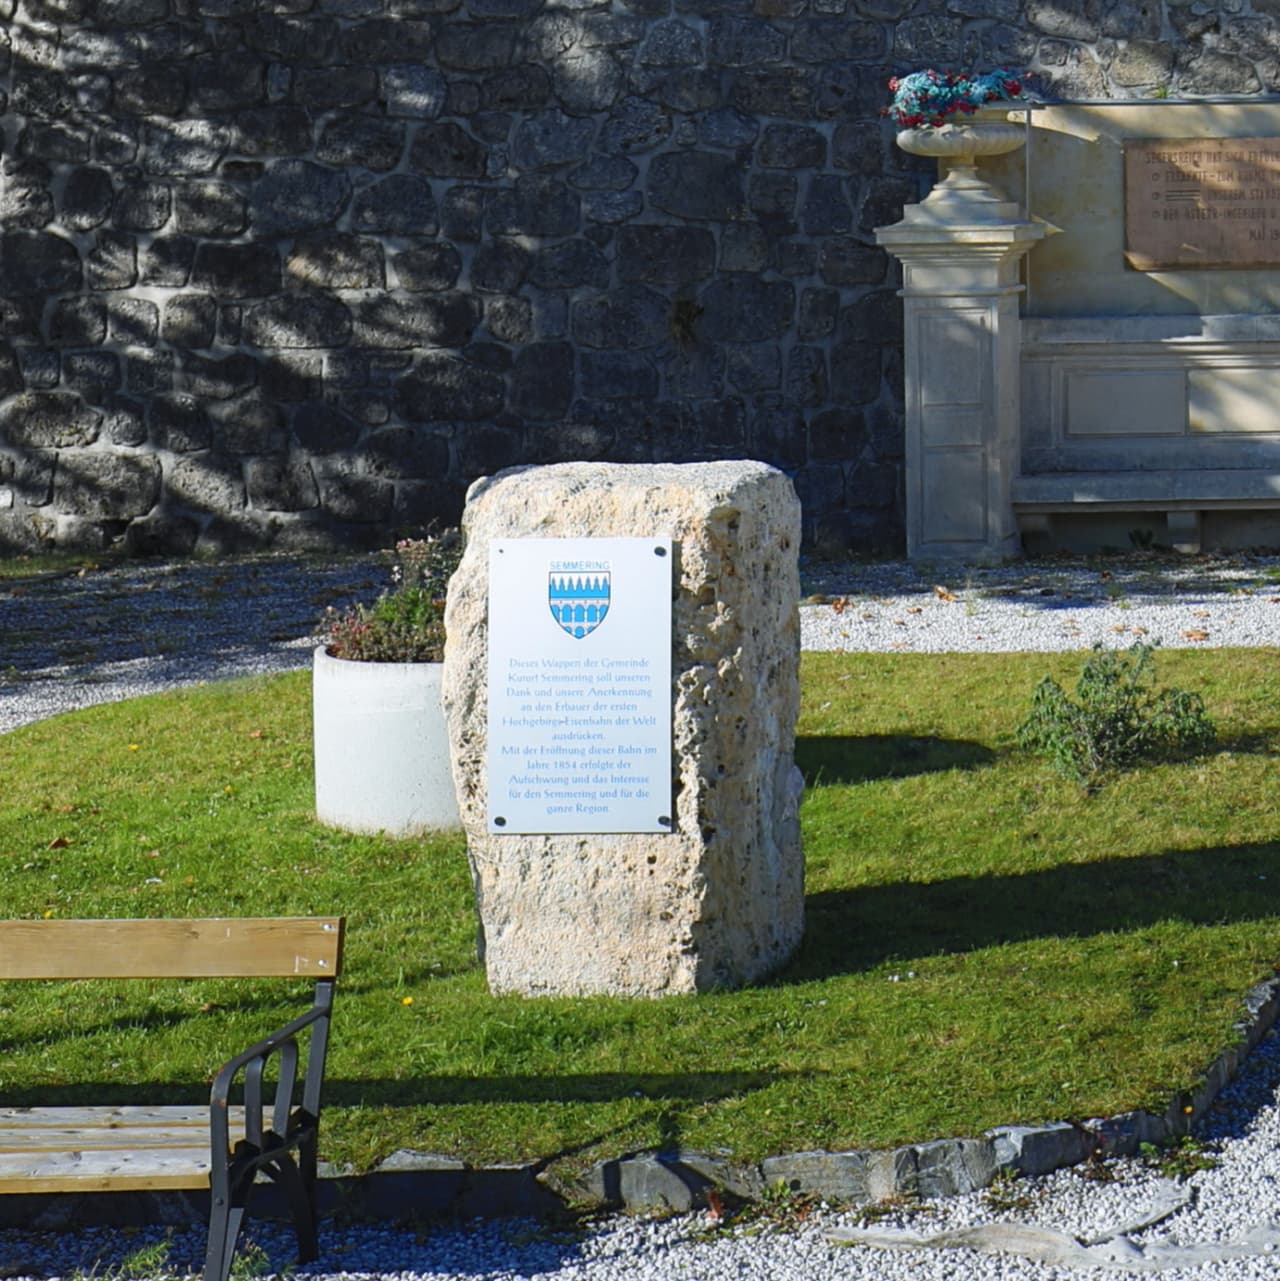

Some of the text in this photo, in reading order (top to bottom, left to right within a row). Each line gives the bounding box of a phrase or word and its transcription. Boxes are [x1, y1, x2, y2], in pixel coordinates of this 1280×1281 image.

[550, 561, 610, 569] SEMMERING
[509, 658, 650, 670] Dieses Wappen der Gemeinde
[508, 673, 651, 683] Kurort Semmering soll unseren
[506, 687, 653, 698] Dank und unsere Anerkennung
[535, 702, 552, 711] den
[555, 702, 590, 711] Erbauer
[593, 702, 608, 711] der
[610, 702, 638, 711] ersten
[502, 716, 657, 727] Hochgebirgs-Eisenbahn der Welt
[501, 745, 657, 756] Mit der Eröffnung dieser Bahn im
[527, 760, 632, 771] Jahre 1854 erfolgte der
[508, 775, 650, 786] Aufschwung und das Interesse
[508, 789, 650, 800] für den Semmering und für die
[546, 806, 573, 815] ganze
